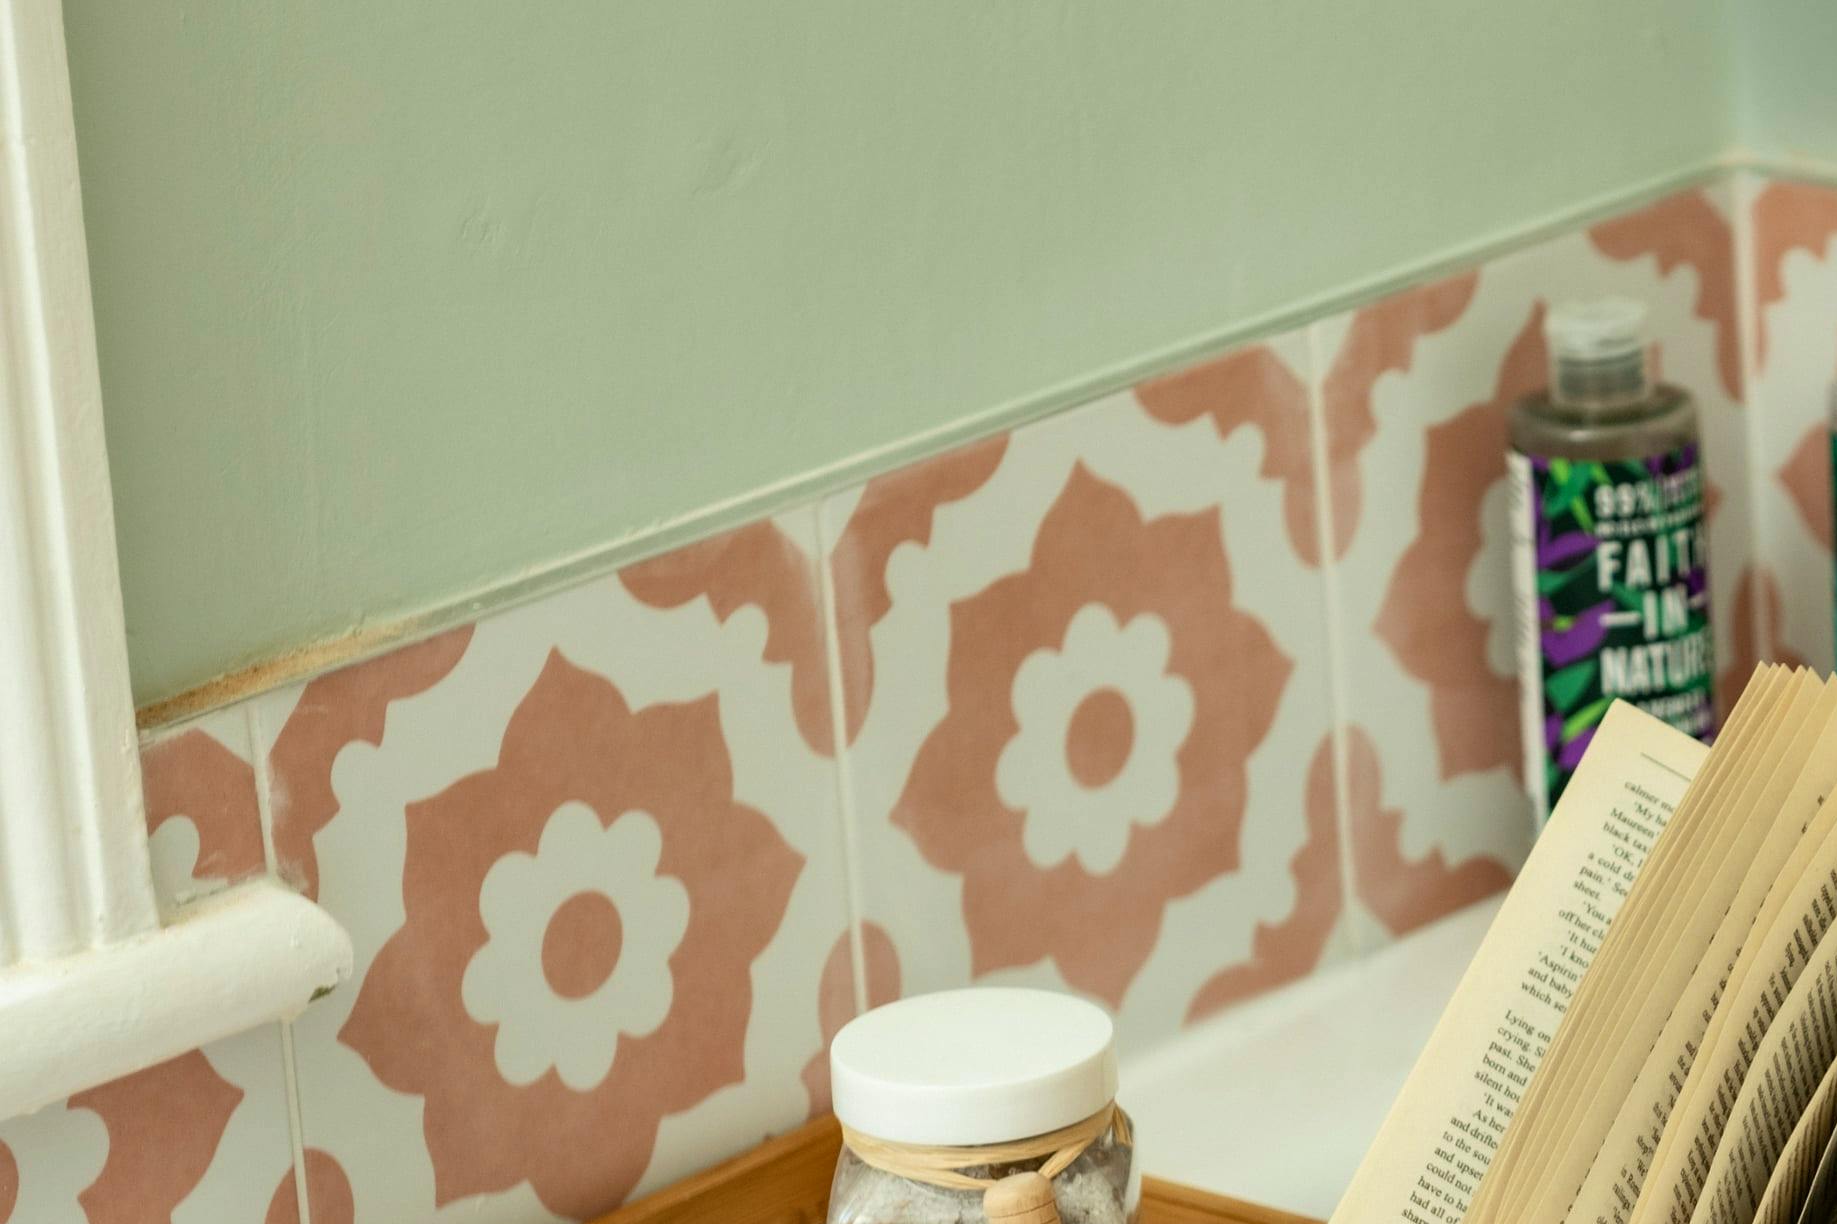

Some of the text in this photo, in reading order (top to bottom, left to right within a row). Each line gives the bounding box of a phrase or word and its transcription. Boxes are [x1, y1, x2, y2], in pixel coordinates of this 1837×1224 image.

[1644, 582, 1688, 640] IN
[1602, 821, 1648, 853] black tax
[1597, 858, 1621, 875] cold
[1558, 909, 1577, 922] off
[1574, 916, 1592, 933] her
[1580, 938, 1598, 954] hur
[1569, 951, 1589, 969] kno
[1528, 967, 1549, 984] and
[1521, 981, 1552, 1005] which
[1505, 1009, 1551, 1043] Lying on
[1482, 1053, 1528, 1087] born and
[1516, 1054, 1536, 1073] She
[1474, 1070, 1503, 1092] silent
[1473, 1109, 1488, 1124] As
[1450, 1116, 1498, 1150] and drifte
[1434, 1146, 1456, 1164] and
[1442, 1131, 1491, 1166] to the sou
[1417, 1175, 1443, 1198] have
[1444, 1192, 1455, 1205] to
[1426, 1161, 1472, 1195] could not
[1409, 1190, 1431, 1210] had
[1430, 1204, 1446, 1219] all
